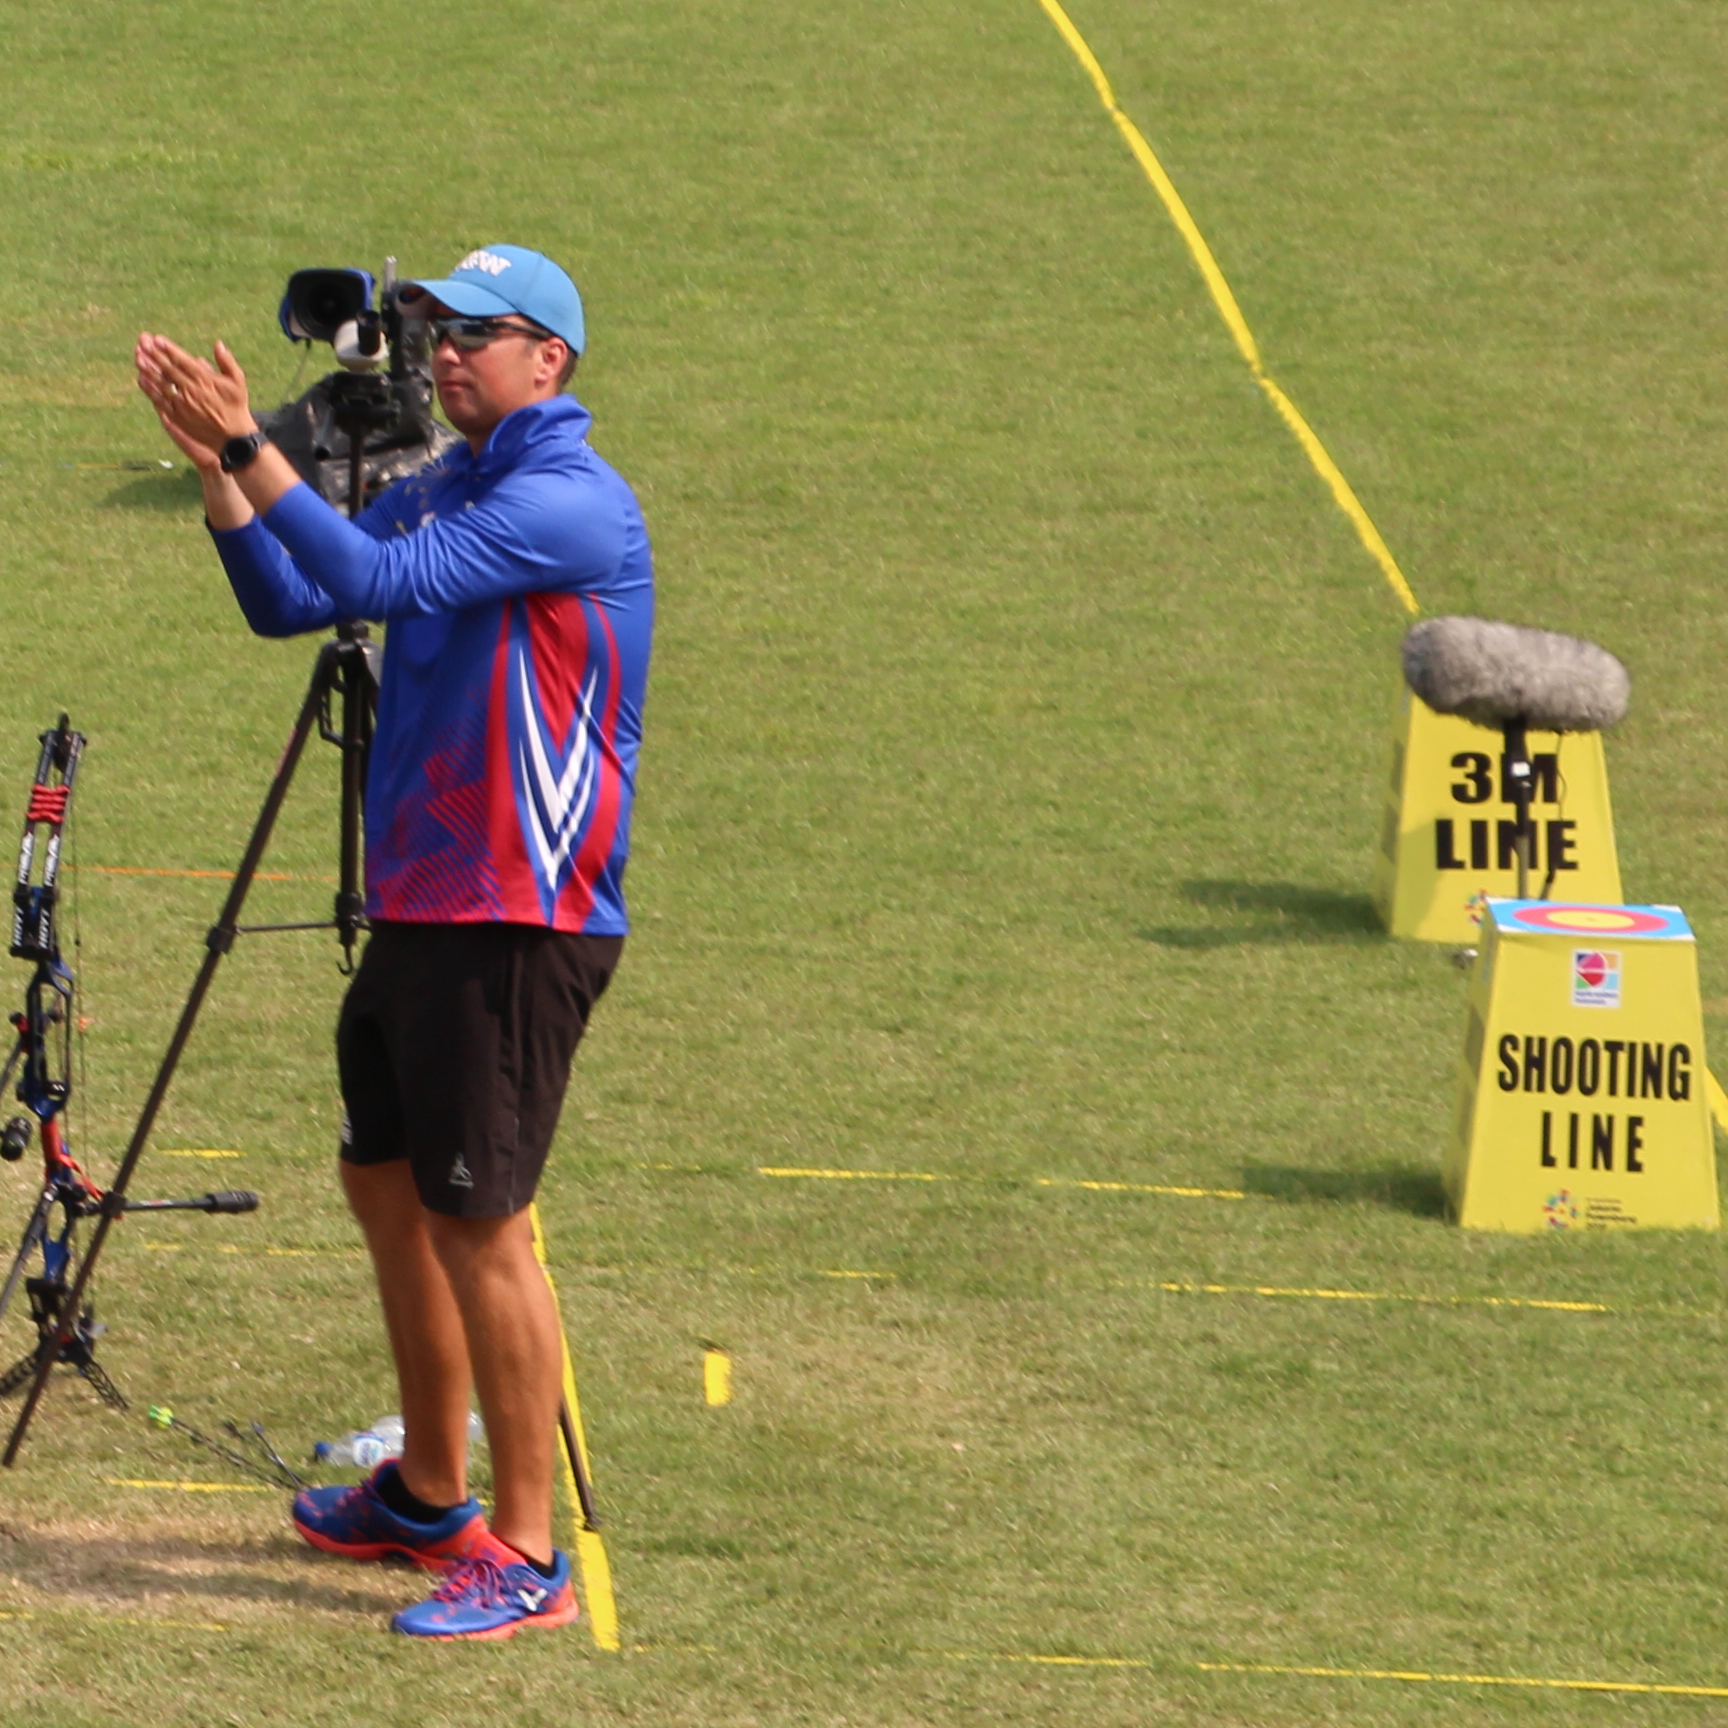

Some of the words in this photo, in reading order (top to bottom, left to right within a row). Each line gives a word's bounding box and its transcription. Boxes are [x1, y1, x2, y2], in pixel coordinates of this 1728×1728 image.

[1451, 751, 1558, 804] 3M
[1436, 818, 1579, 871] LINE
[1497, 1033, 1691, 1102] SHOOTING
[1540, 1110, 1644, 1173] LINE
